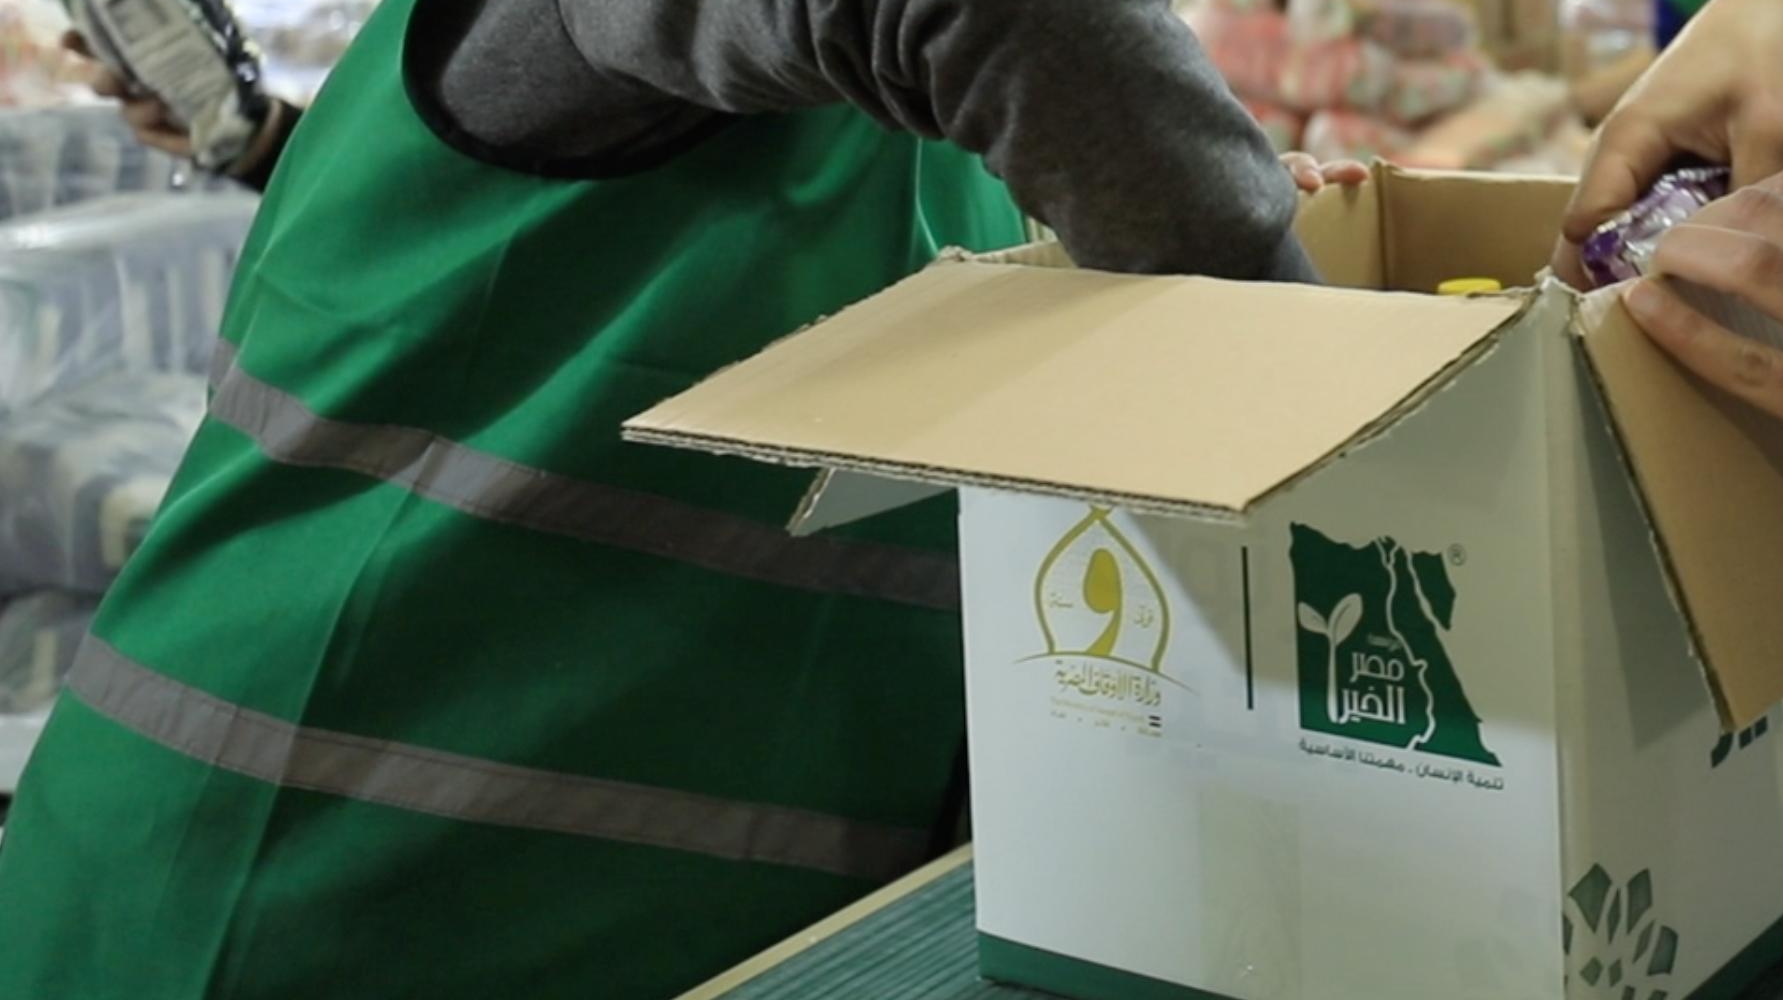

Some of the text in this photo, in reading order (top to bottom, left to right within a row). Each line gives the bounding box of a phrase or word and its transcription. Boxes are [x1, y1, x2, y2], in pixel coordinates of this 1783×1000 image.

[1350, 651, 1405, 683] مصر
[1339, 684, 1405, 725] الخير
[1466, 768, 1504, 791] تنمية
